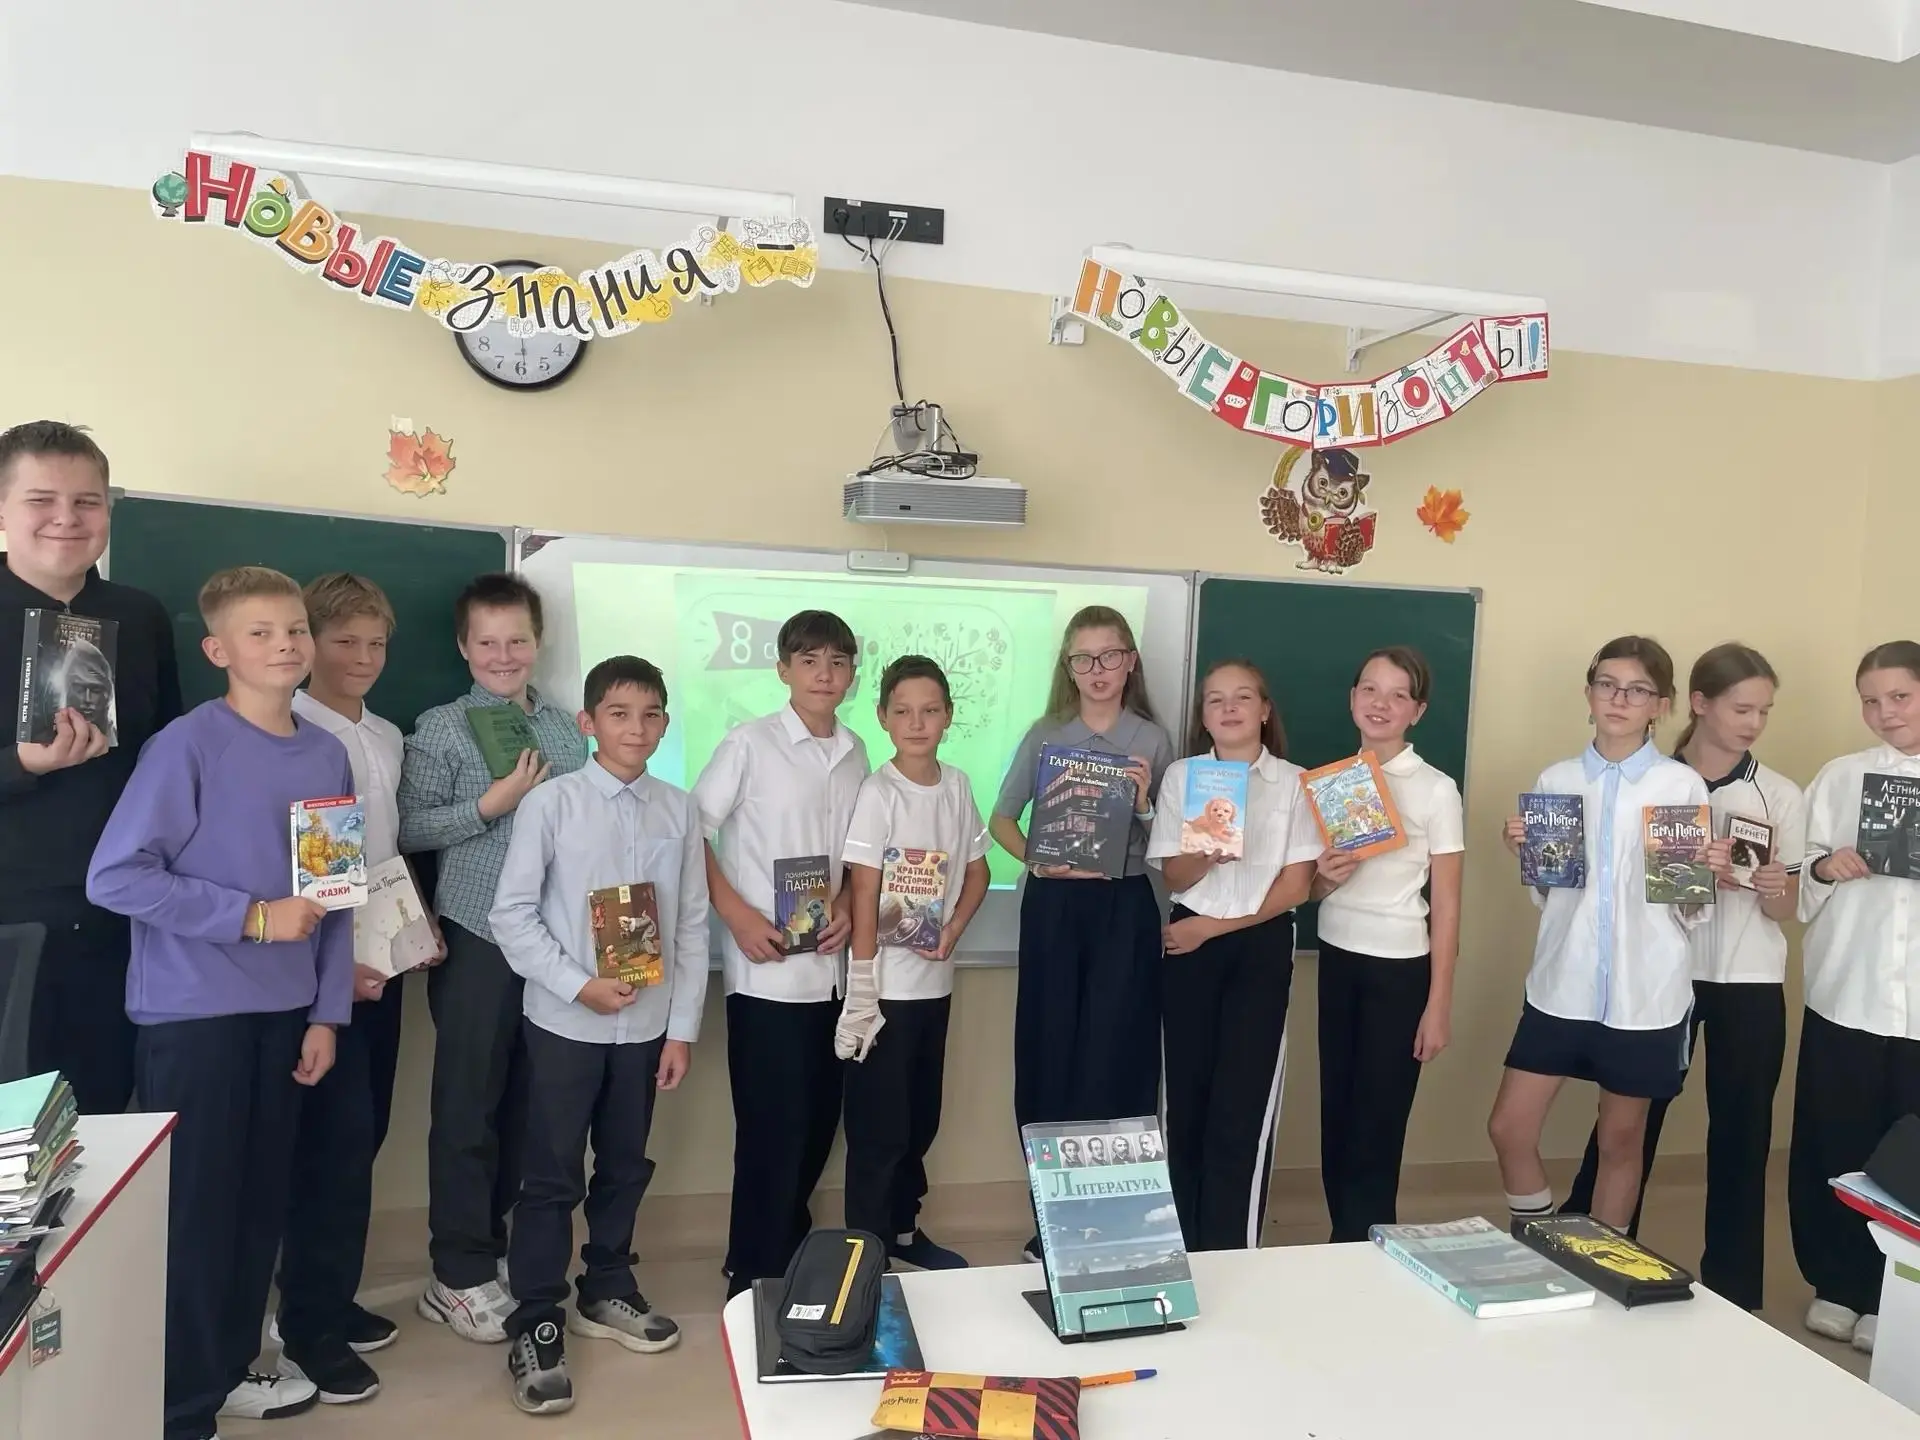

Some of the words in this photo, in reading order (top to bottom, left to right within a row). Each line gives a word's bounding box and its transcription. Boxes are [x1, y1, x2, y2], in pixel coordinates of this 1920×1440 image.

[183, 151, 426, 308] НОВЫЕ
[1073, 258, 1234, 407] НОВЫЕ
[478, 336, 490, 351] 8
[553, 343, 564, 356] 4
[494, 356, 504, 369] 7
[515, 361, 527, 375] 6
[539, 357, 550, 371] 5
[1252, 321, 1540, 437] ГОРИЗОНТЫ!
[730, 620, 752, 664] 8
[1049, 755, 1083, 770] ГАРРИ
[896, 865, 935, 876] КРАТКАЯ
[785, 878, 825, 892] ПАНДА
[897, 875, 933, 885] ИСТОРИЯ
[317, 886, 351, 898] СКАЗКИ
[888, 883, 938, 896] ВСЕЛЕННОЙ
[620, 970, 660, 983] ШТАНКА
